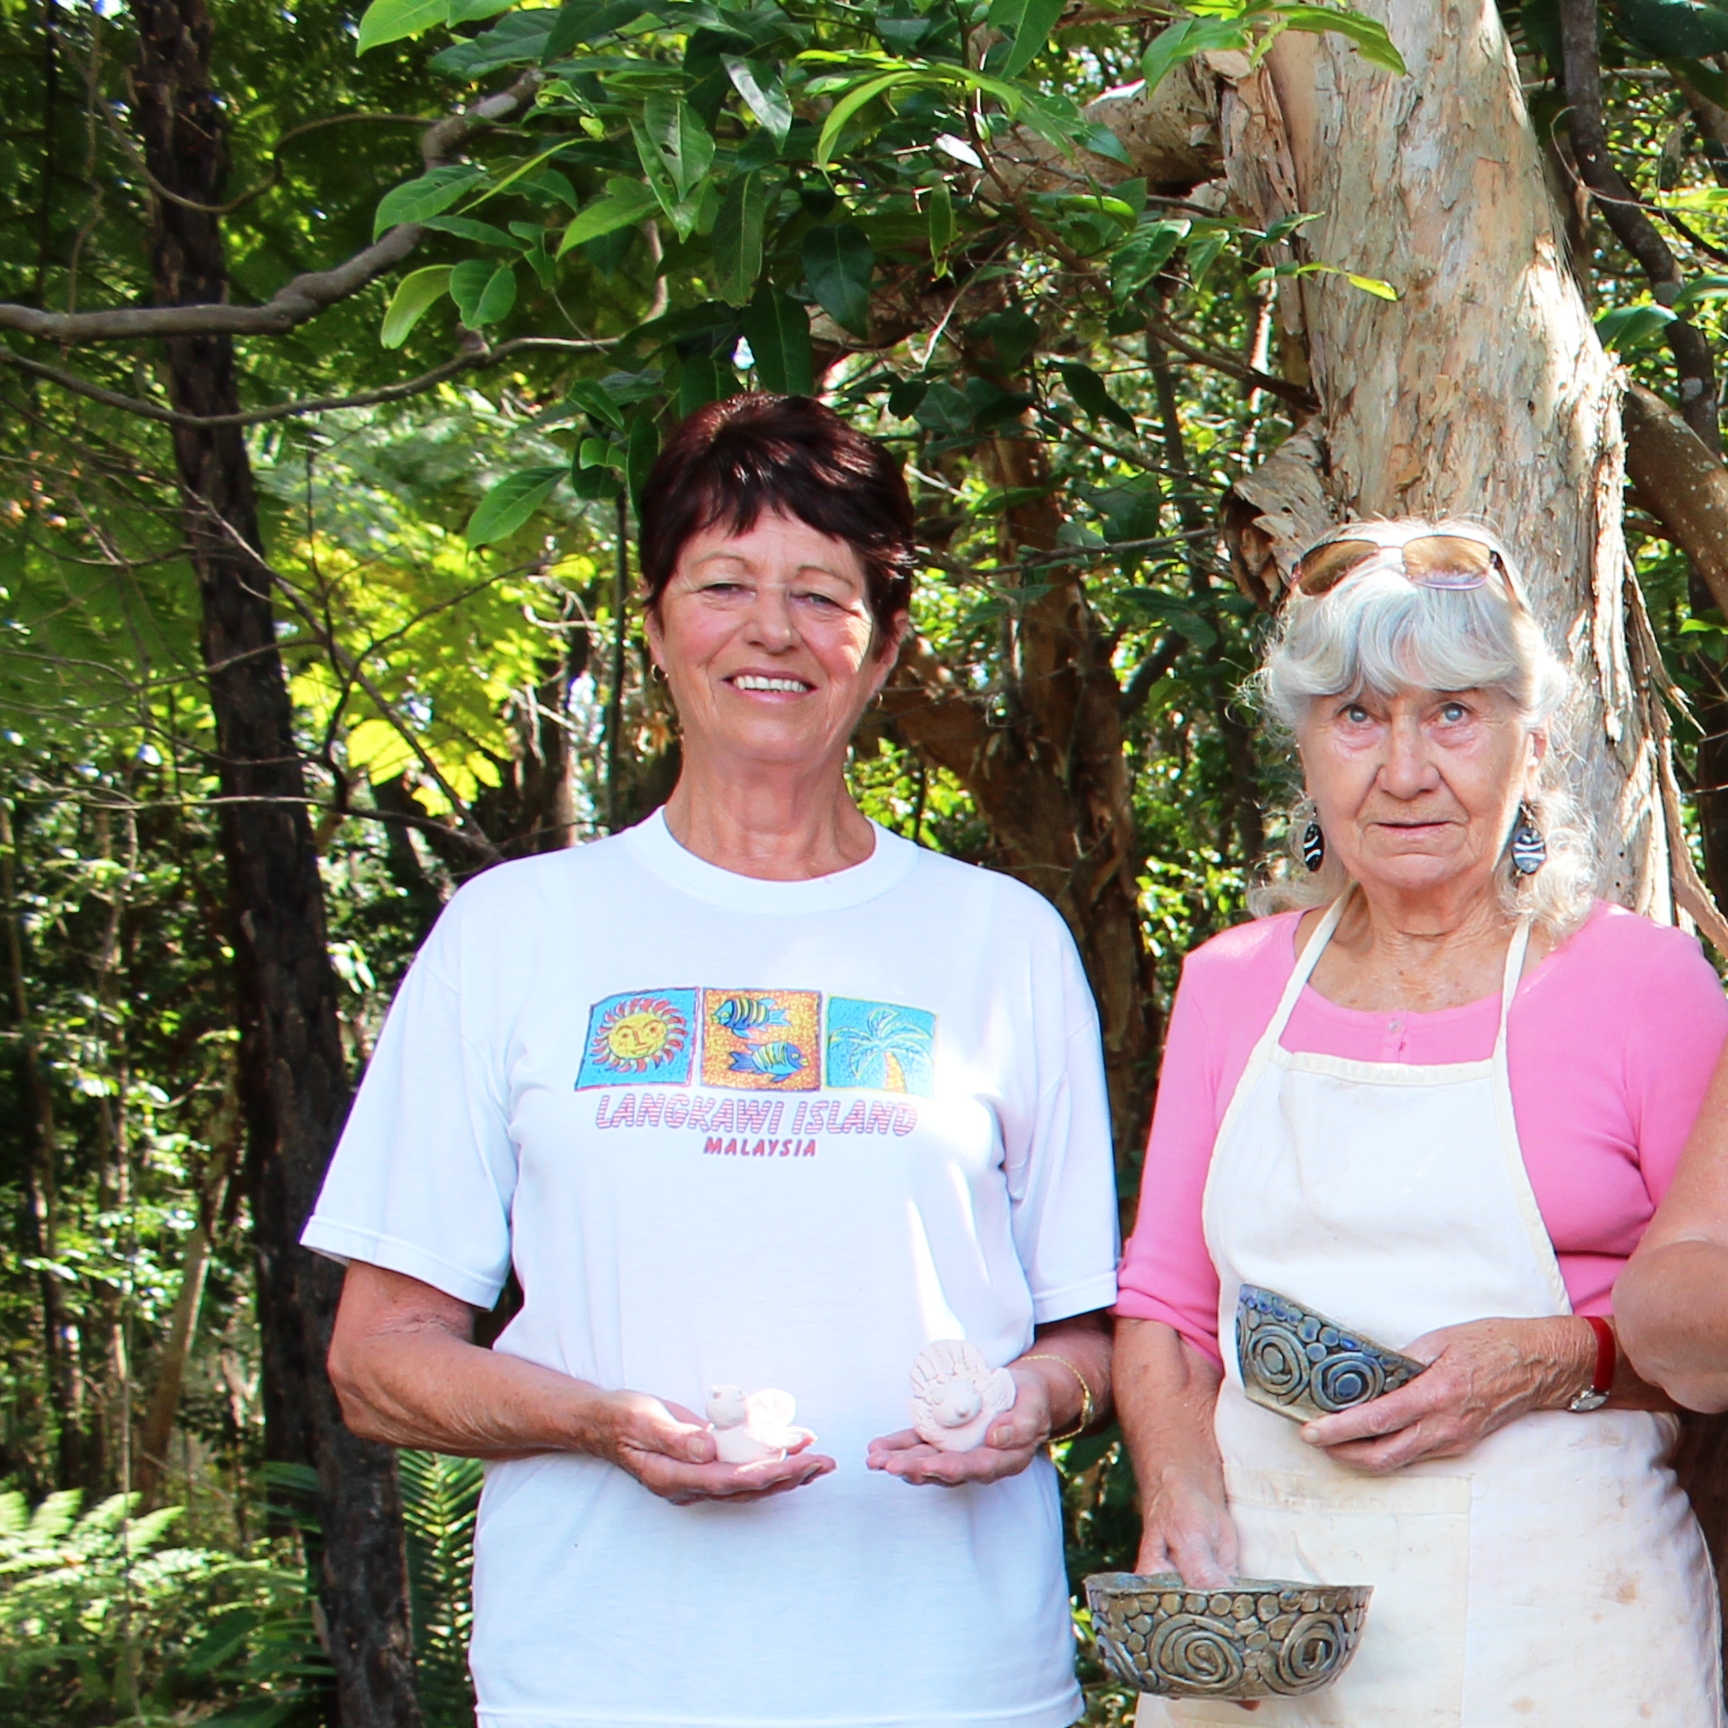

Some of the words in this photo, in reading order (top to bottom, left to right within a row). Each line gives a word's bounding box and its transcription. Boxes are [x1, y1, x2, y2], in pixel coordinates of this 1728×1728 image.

[595, 1093, 785, 1135] LANGKAWI
[791, 1100, 918, 1137] ISLAND
[703, 1136, 817, 1158] MALAYSIA
